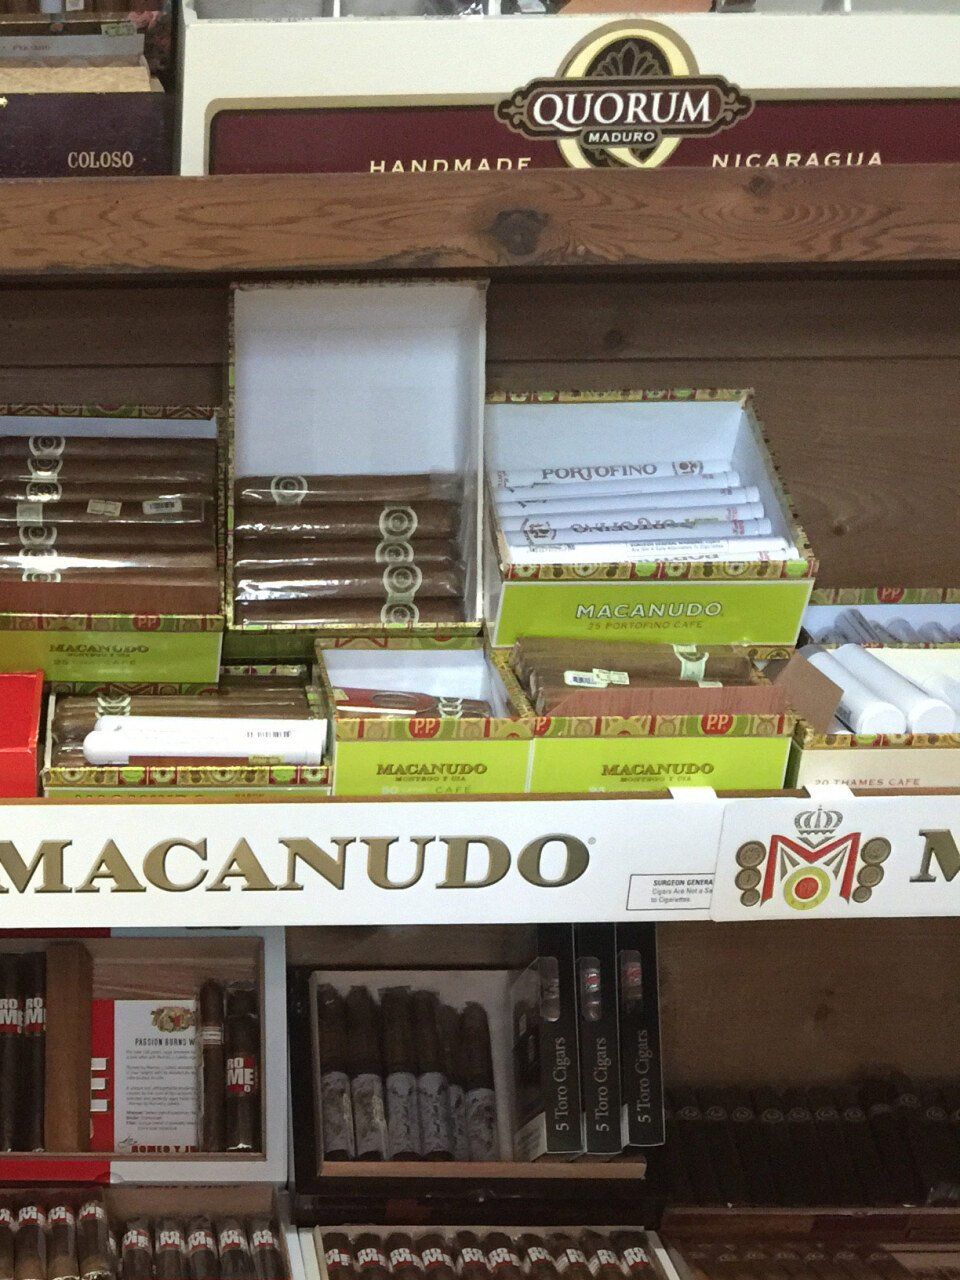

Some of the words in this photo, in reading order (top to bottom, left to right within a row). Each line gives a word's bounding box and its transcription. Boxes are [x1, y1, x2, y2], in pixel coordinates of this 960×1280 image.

[533, 91, 712, 131] QUORUM
[588, 131, 655, 144] MADURO
[67, 150, 134, 169] COLOSO
[369, 157, 532, 174] HANDMADE
[712, 152, 883, 168] NICARAGUA
[541, 463, 658, 484] PORTOFINO
[575, 602, 723, 620] MACANUDO
[376, 763, 488, 776] MACANUDO
[601, 763, 715, 776] MACANUDO
[553, 1036, 571, 1080] Cigars
[594, 1037, 611, 1081] Cigars
[635, 1029, 654, 1073] Cigars
[555, 1083, 569, 1118] Toro
[595, 1084, 609, 1119] Toro
[637, 1075, 651, 1111] Toro
[555, 1122, 569, 1131] 5
[596, 1123, 610, 1132] 5
[638, 1115, 651, 1124] 5
